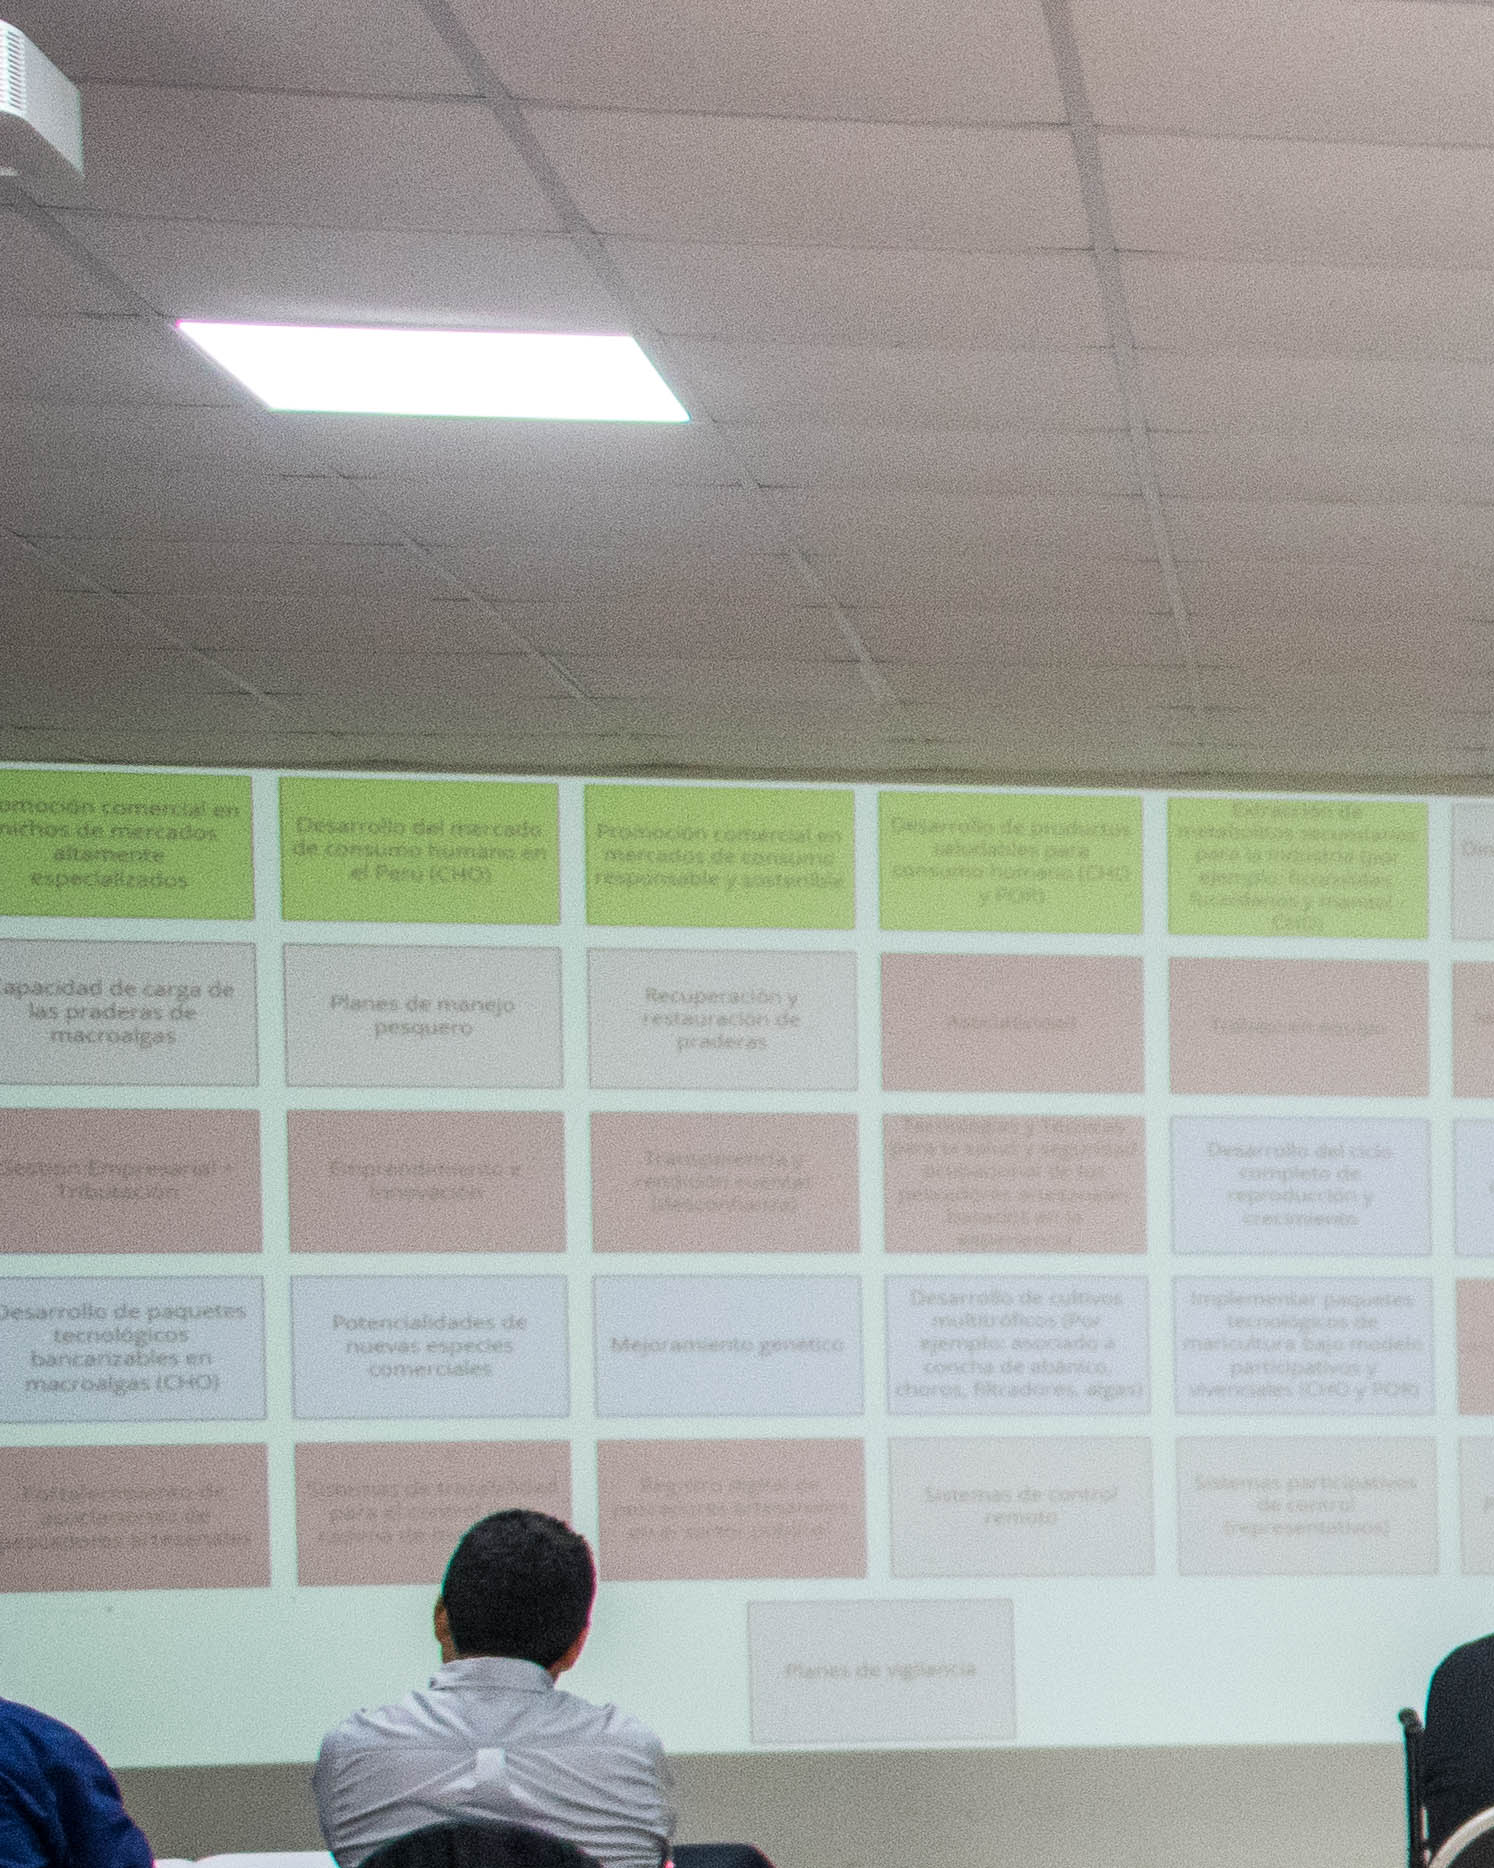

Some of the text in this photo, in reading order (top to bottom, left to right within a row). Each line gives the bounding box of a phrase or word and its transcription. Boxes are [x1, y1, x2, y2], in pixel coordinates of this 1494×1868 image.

[0, 798, 240, 819] omoción comercial en
[0, 822, 218, 842] nichos de mercados
[52, 846, 165, 864] altamente
[291, 840, 319, 857] de
[520, 848, 548, 861] en
[29, 871, 189, 894] especializados
[2, 980, 235, 1003] apacidad de carga de
[643, 988, 799, 1009] Recuperación y
[28, 1004, 197, 1025] las praderas de
[328, 996, 516, 1018] Planes de manejo
[640, 1012, 801, 1028] restauración de
[49, 1027, 177, 1048] macroalgas
[374, 1023, 474, 1040] pesquero
[676, 1034, 768, 1054] praderas
[1335, 1166, 1362, 1182] de
[1017, 1291, 1043, 1306] de
[0, 1303, 247, 1323] Desarrollo de paquetes
[331, 1315, 528, 1331] Potencialidades de
[52, 1326, 190, 1347] tecnológicos
[345, 1338, 515, 1358] nuevas especies
[609, 1337, 753, 1357] Mejoramiento
[30, 1350, 213, 1368] bancarizables en
[998, 1359, 1024, 1375] de
[367, 1361, 493, 1378] comerciales
[24, 1375, 220, 1396] macroalgas (CHO)
[1016, 1487, 1043, 1503] de
[1256, 1498, 1282, 1513] de
